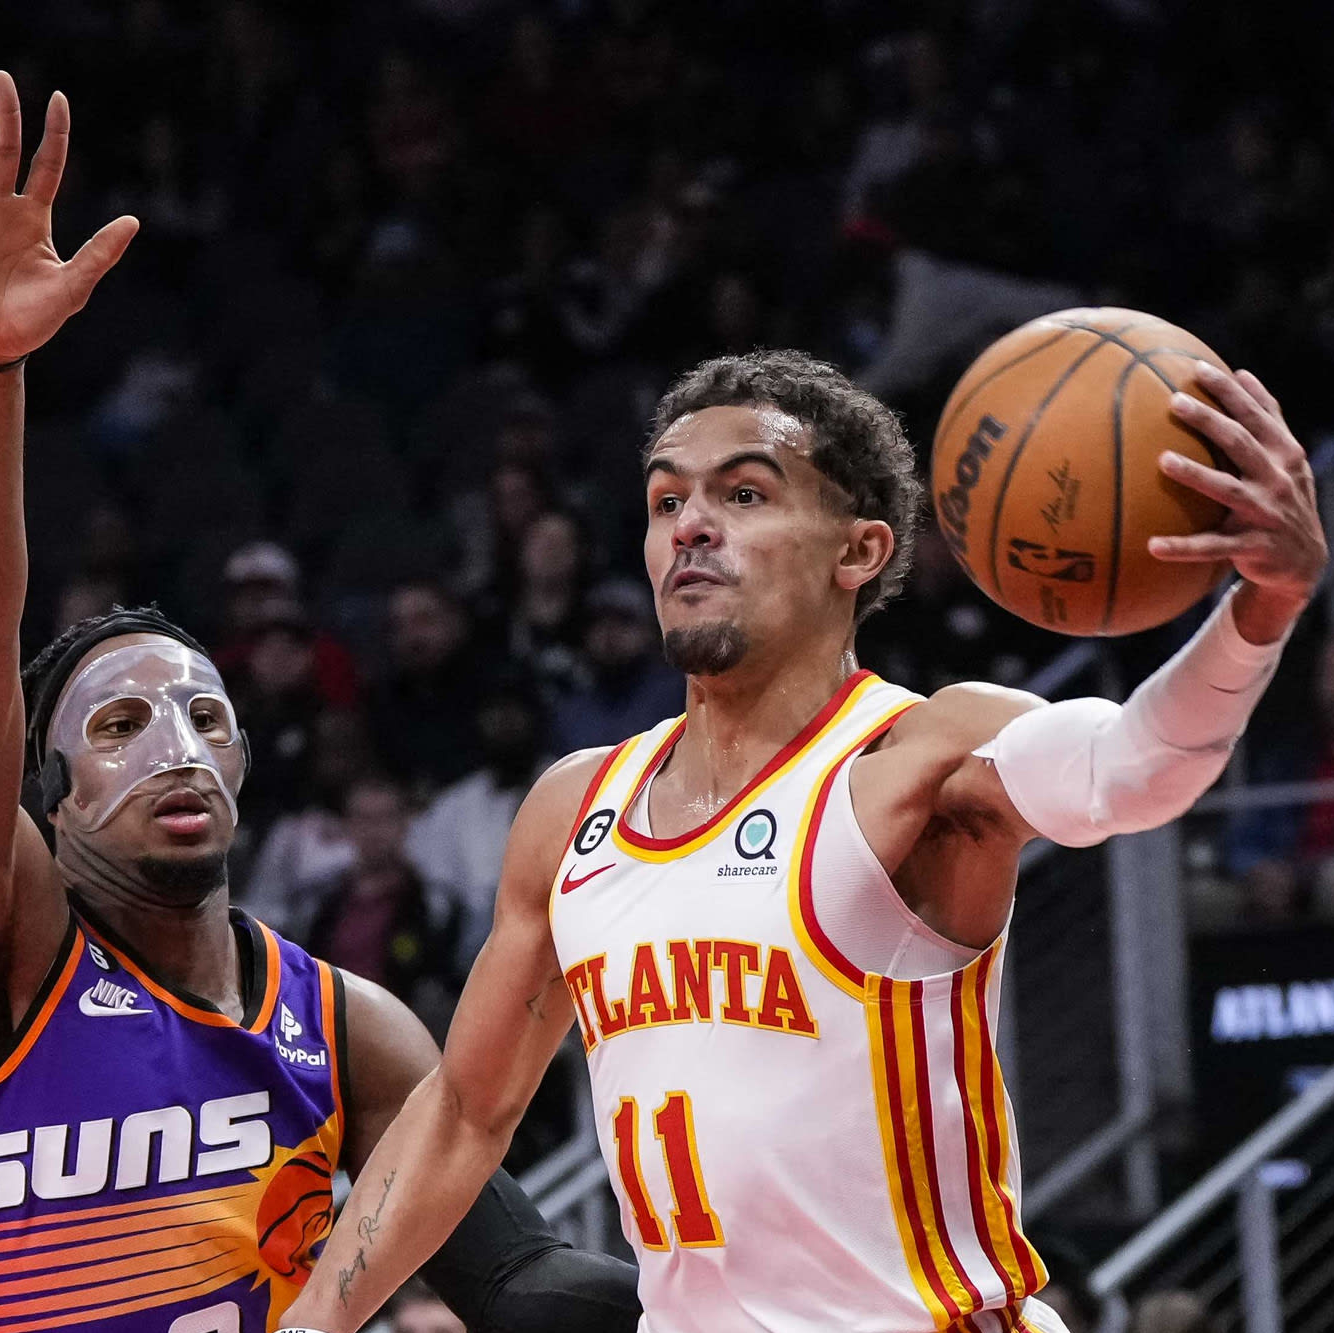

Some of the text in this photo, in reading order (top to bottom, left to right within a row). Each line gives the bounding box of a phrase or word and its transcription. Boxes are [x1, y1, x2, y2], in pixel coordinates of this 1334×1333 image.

[580, 815, 610, 850] 6
[717, 864, 778, 877] sharecare
[91, 978, 138, 1010] NIKE
[564, 938, 820, 1057] TLANTA
[612, 1090, 726, 1252] 11
